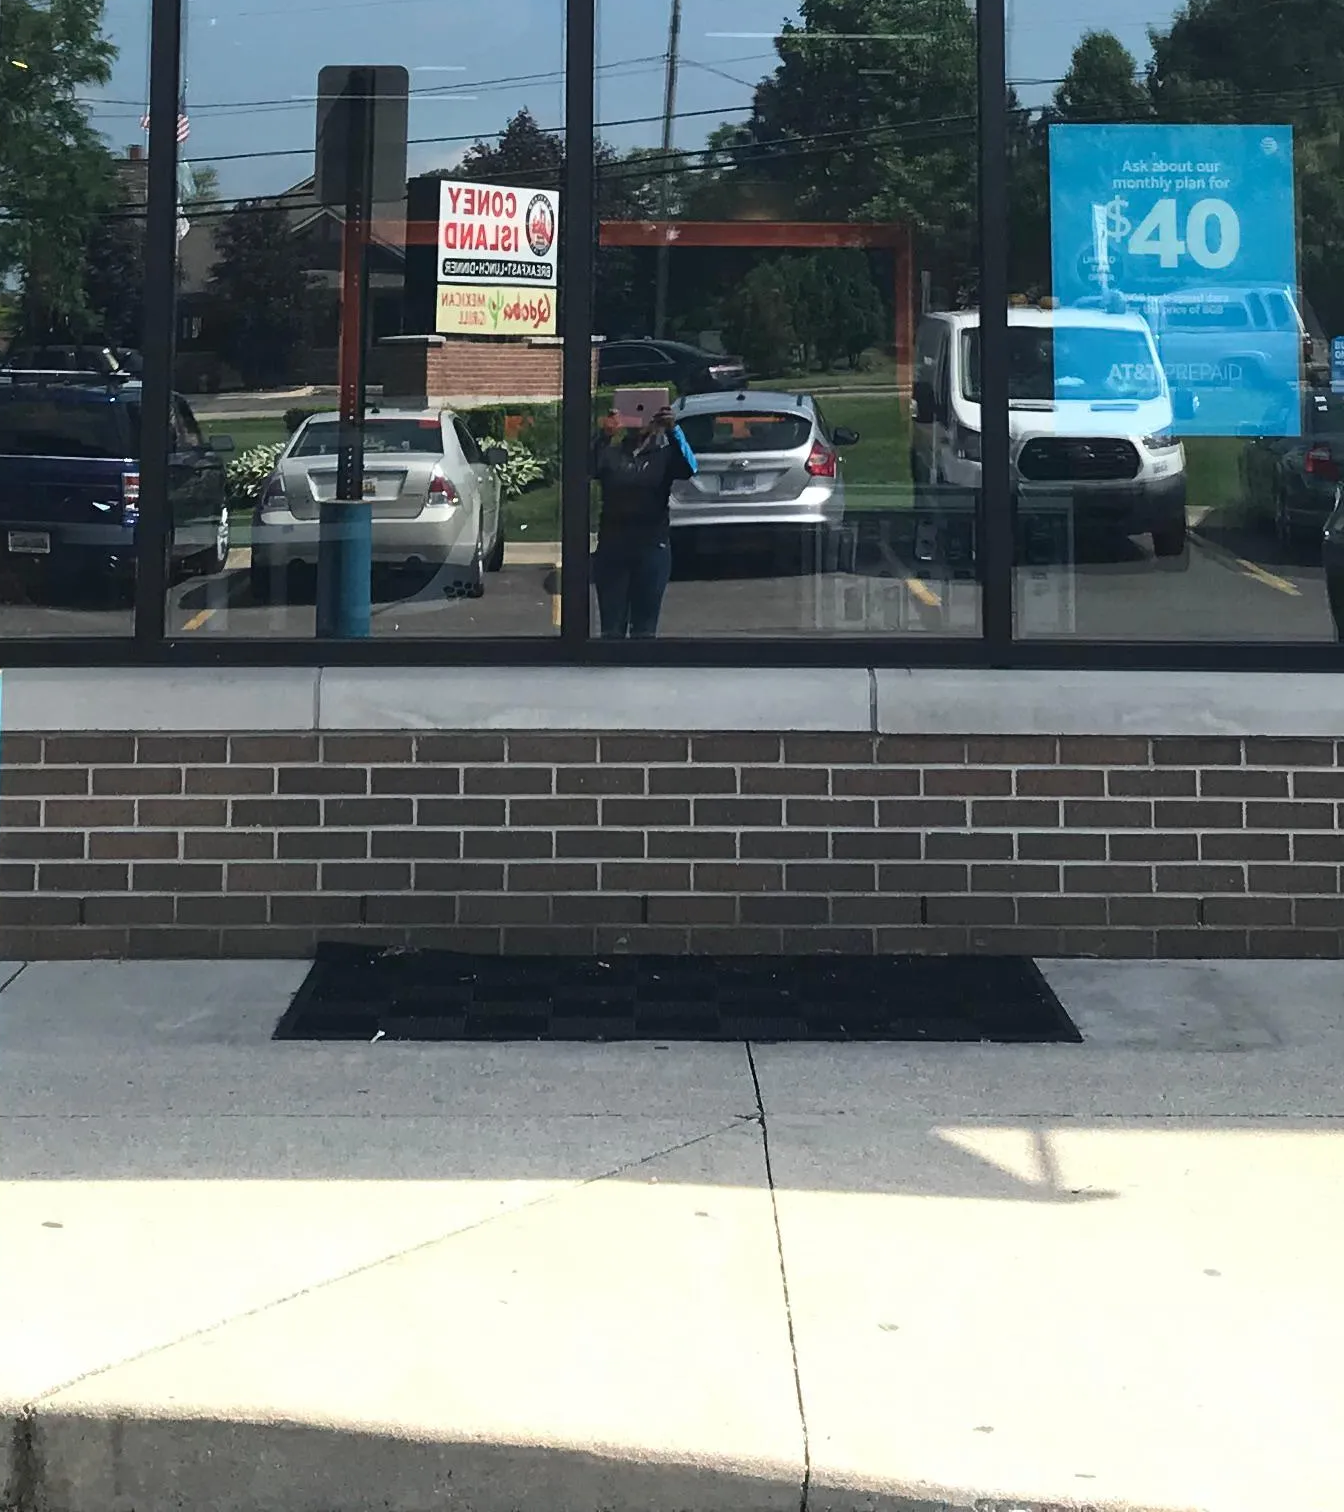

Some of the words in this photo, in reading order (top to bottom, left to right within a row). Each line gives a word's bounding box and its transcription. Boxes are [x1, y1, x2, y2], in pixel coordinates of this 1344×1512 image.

[1121, 159, 1149, 173] Ask
[1152, 159, 1194, 173] about
[1196, 162, 1222, 173] our
[1112, 176, 1172, 193] monthly
[1174, 176, 1206, 192] plan
[1207, 176, 1231, 189] for
[1107, 363, 1157, 381] AT&T
[1164, 363, 1243, 381] PREPAID
